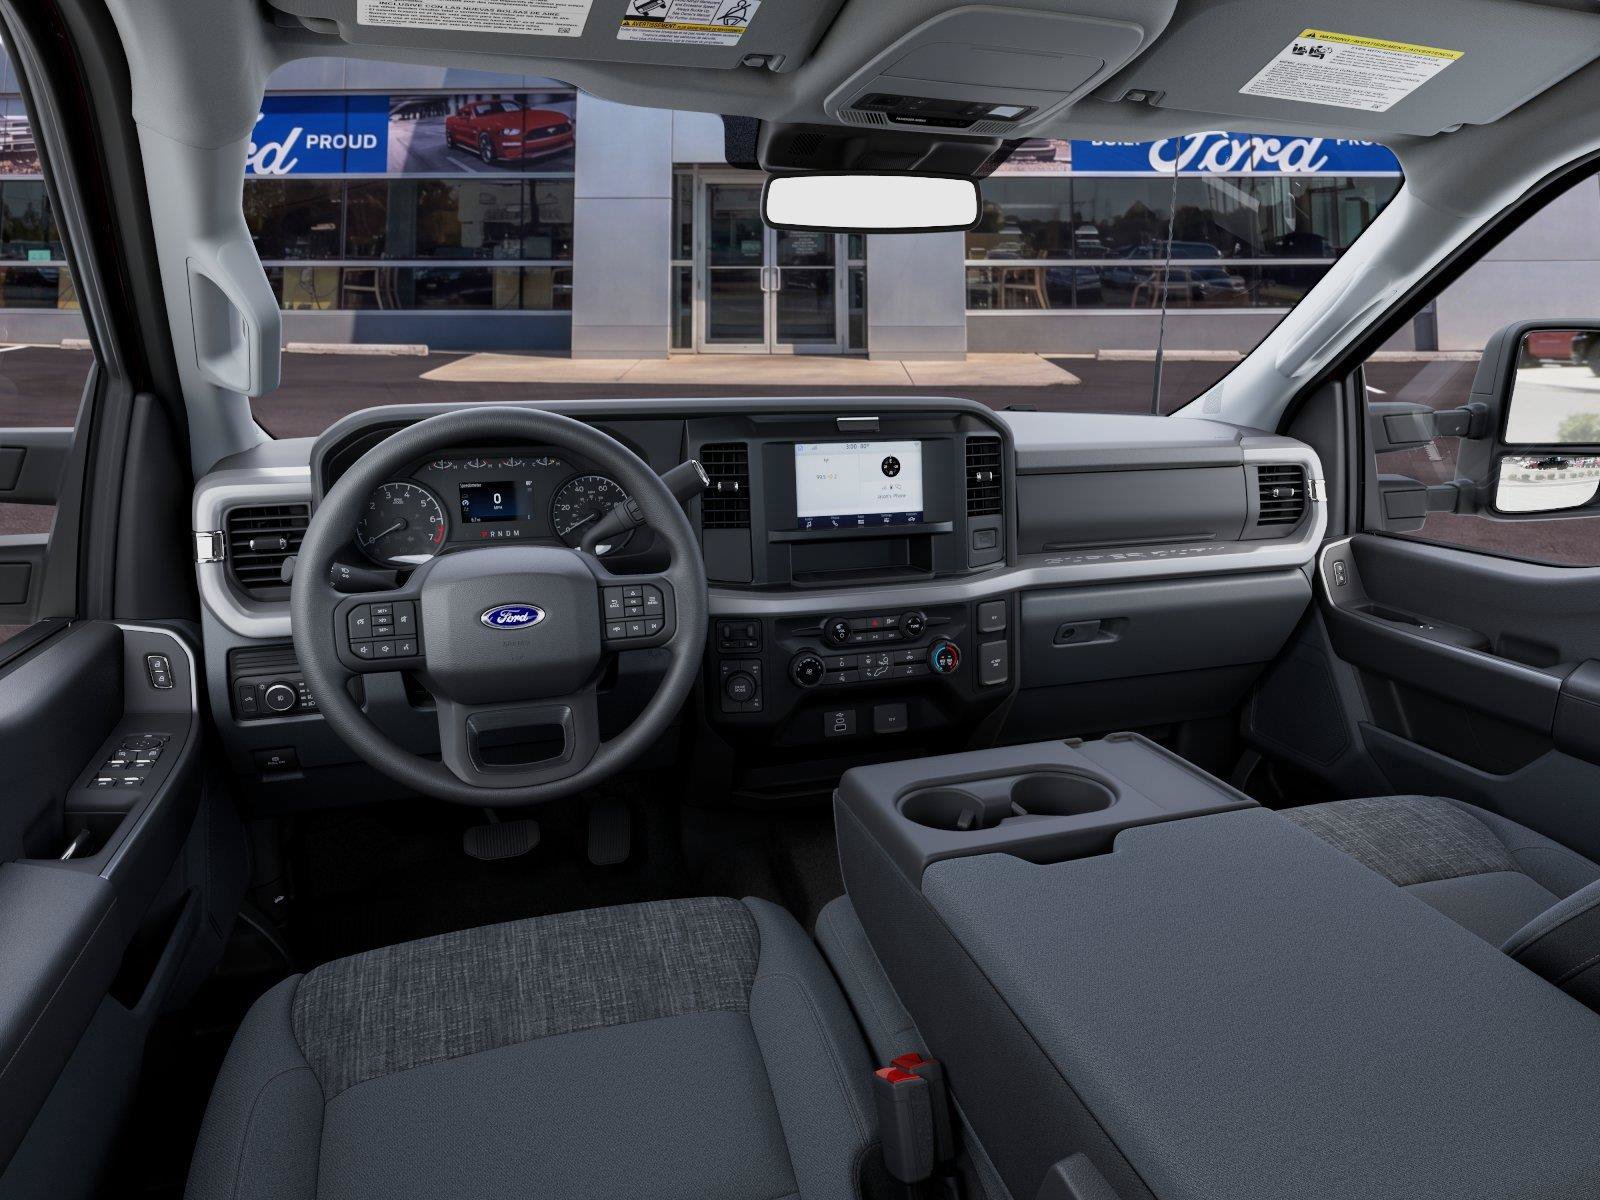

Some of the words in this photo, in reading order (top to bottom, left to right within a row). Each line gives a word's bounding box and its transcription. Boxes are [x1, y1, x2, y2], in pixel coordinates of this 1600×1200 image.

[632, 21, 676, 29] AVERTISSEMENT
[306, 134, 377, 149] PROUD
[1149, 131, 1328, 172] Ford
[385, 491, 391, 499] 3
[404, 491, 410, 499] 4
[493, 493, 502, 504] 0
[369, 502, 376, 510] 2
[420, 499, 427, 507] 5
[428, 533, 434, 541] 7
[497, 609, 529, 624] Ford
